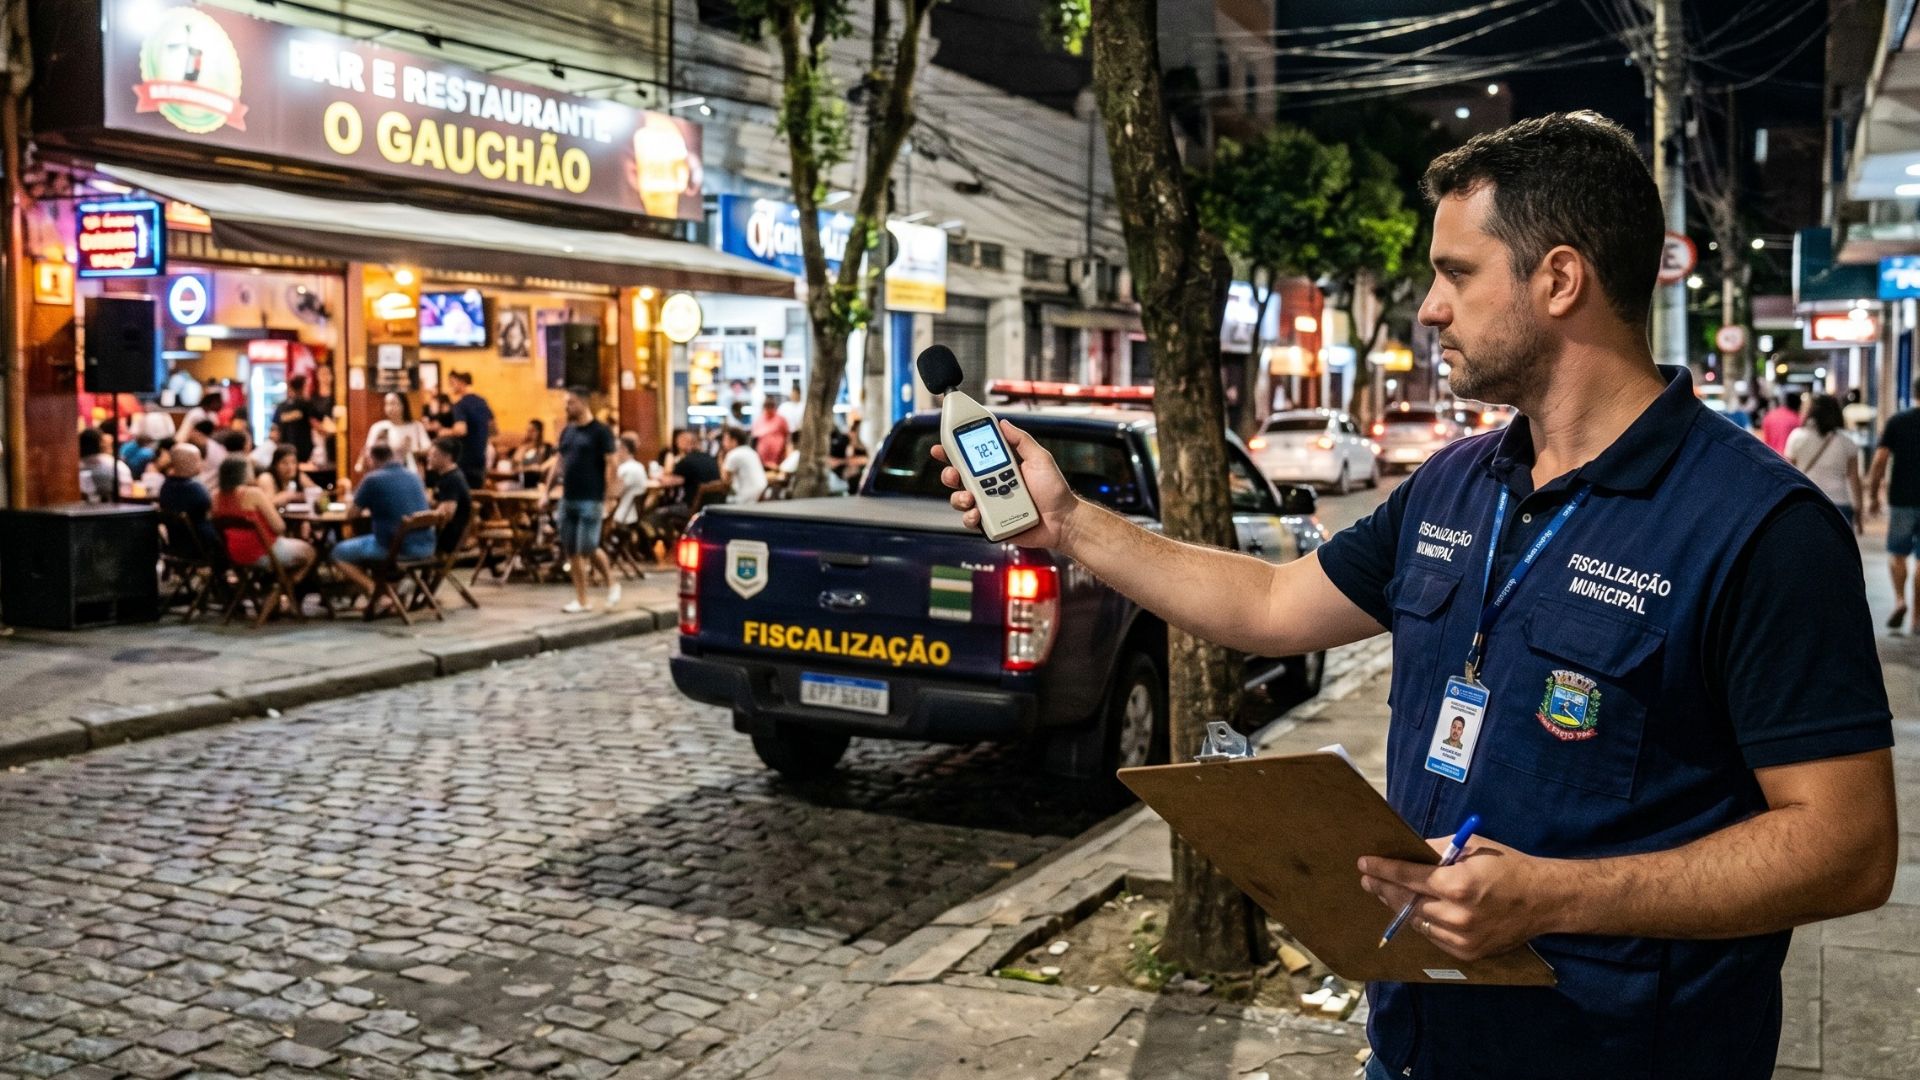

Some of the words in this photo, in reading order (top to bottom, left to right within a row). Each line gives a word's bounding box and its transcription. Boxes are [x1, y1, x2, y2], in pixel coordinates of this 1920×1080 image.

[289, 39, 366, 93] BAR
[372, 58, 396, 99] E
[403, 66, 612, 143] RESTAURANTE
[323, 100, 363, 155] O
[376, 111, 591, 194] GAUCHÃO
[1567, 553, 1672, 597] FISCALIZAÇÃO
[1569, 577, 1646, 615] MUNICIPAL
[743, 621, 951, 668] FISCALIZAÇÃO
